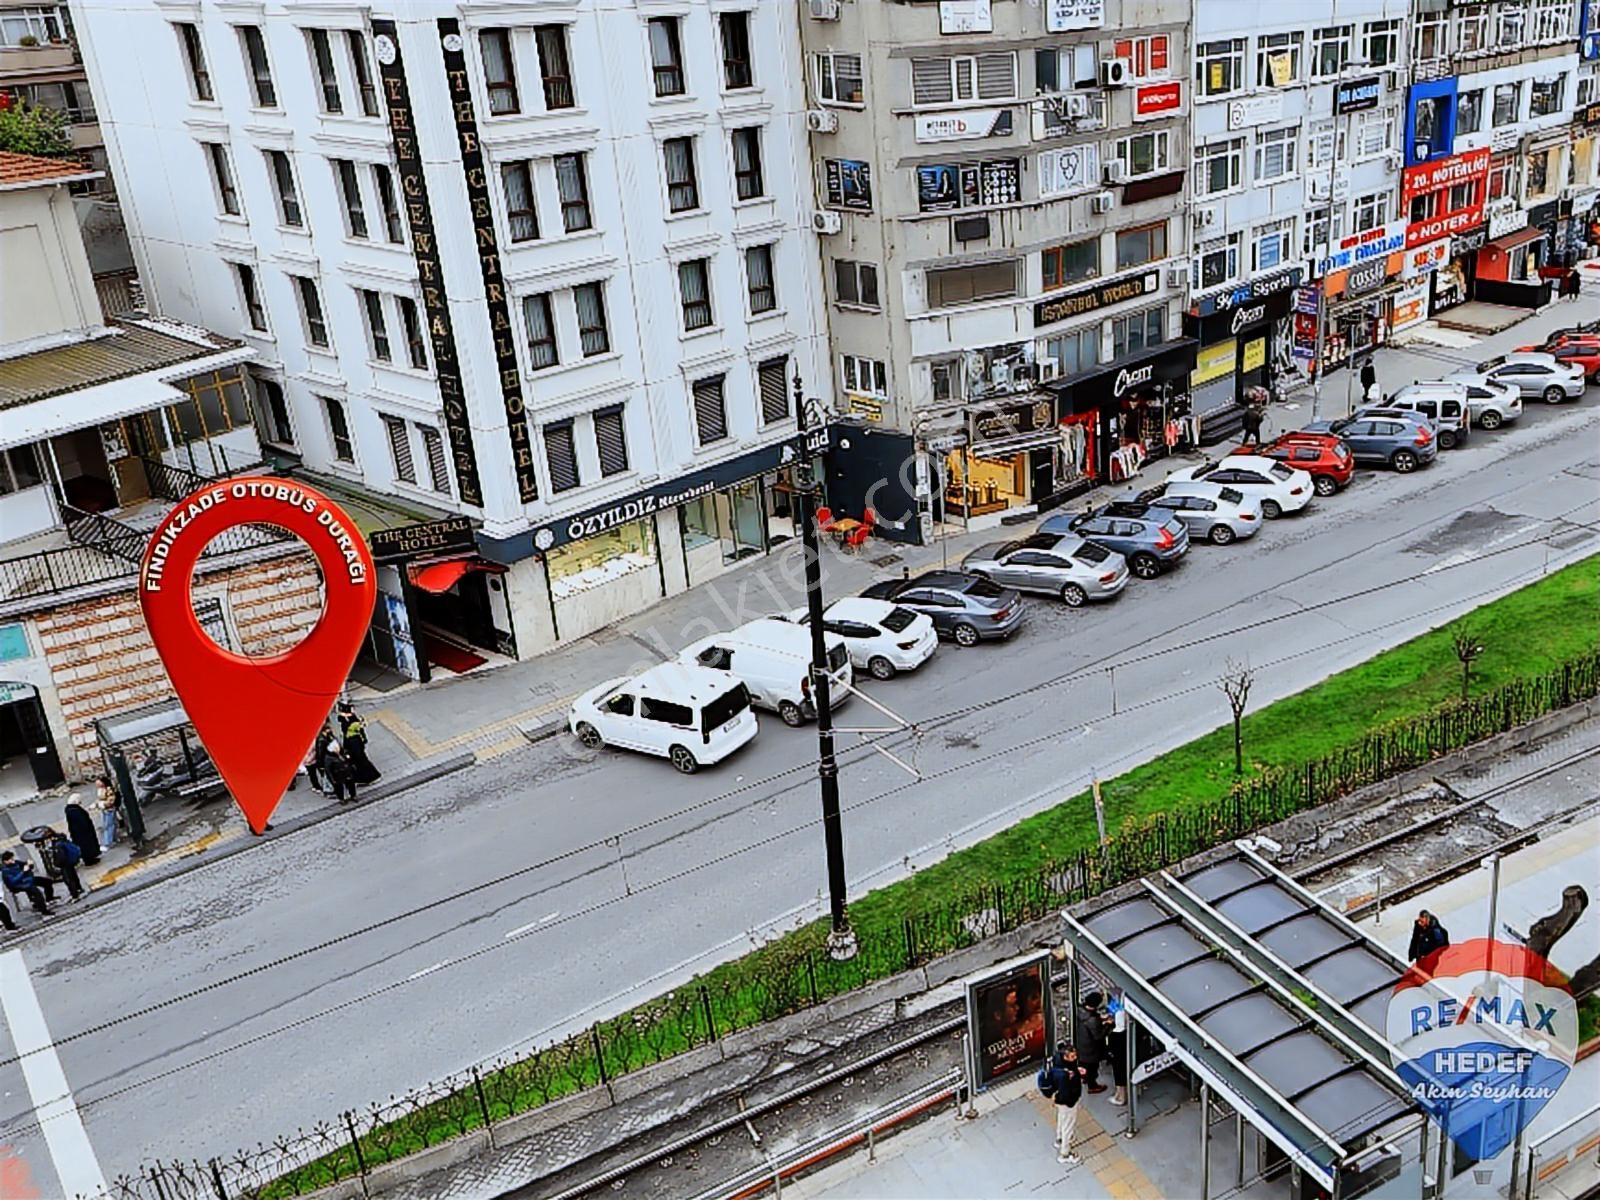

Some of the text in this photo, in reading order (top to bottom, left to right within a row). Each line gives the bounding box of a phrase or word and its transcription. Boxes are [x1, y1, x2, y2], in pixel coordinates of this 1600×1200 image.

[1420, 212, 1469, 239] NOTER
[450, 71, 537, 494] THE CENTRAL HOTEL
[567, 494, 658, 540] ÖZYILDIZ
[374, 520, 469, 547] THE CENTRAL
[399, 534, 448, 550] HOTEL
